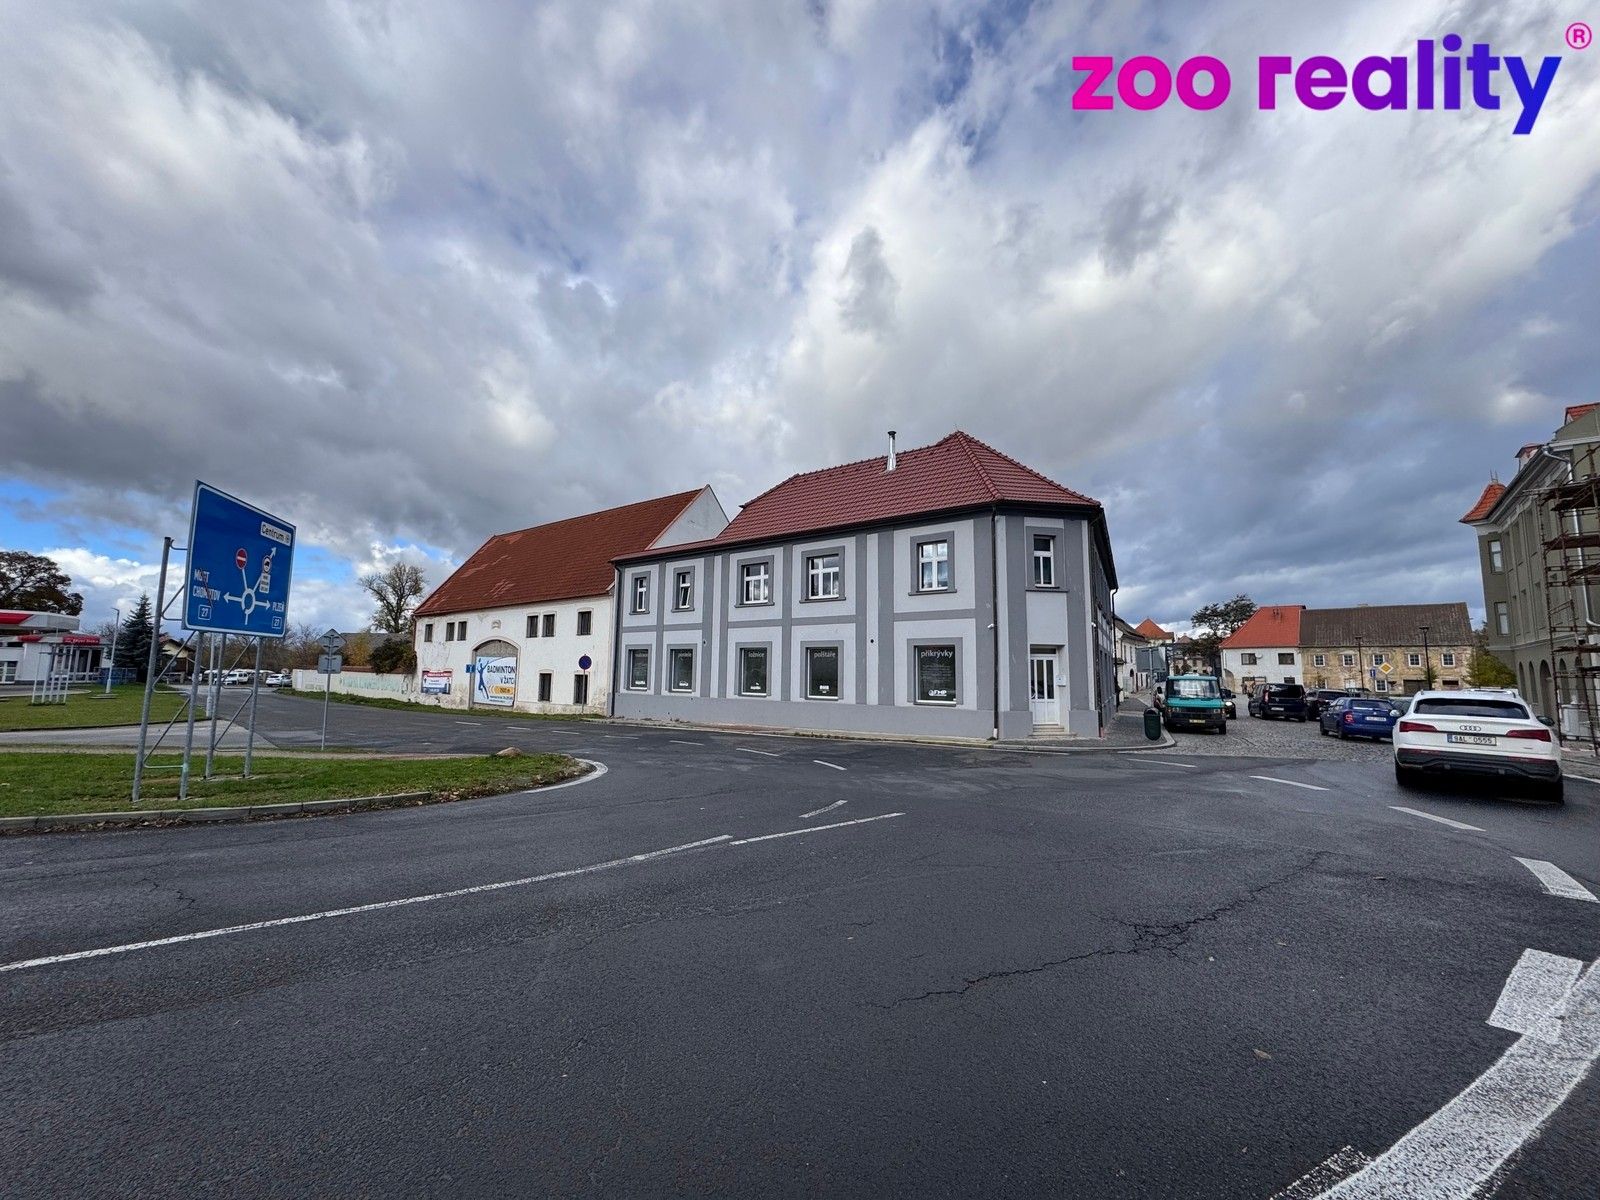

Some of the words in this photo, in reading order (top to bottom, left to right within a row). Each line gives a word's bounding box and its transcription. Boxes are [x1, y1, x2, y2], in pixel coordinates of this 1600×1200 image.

[262, 524, 284, 541] Centrum
[201, 607, 209, 617] 27
[487, 665, 516, 674] BADMINTON
